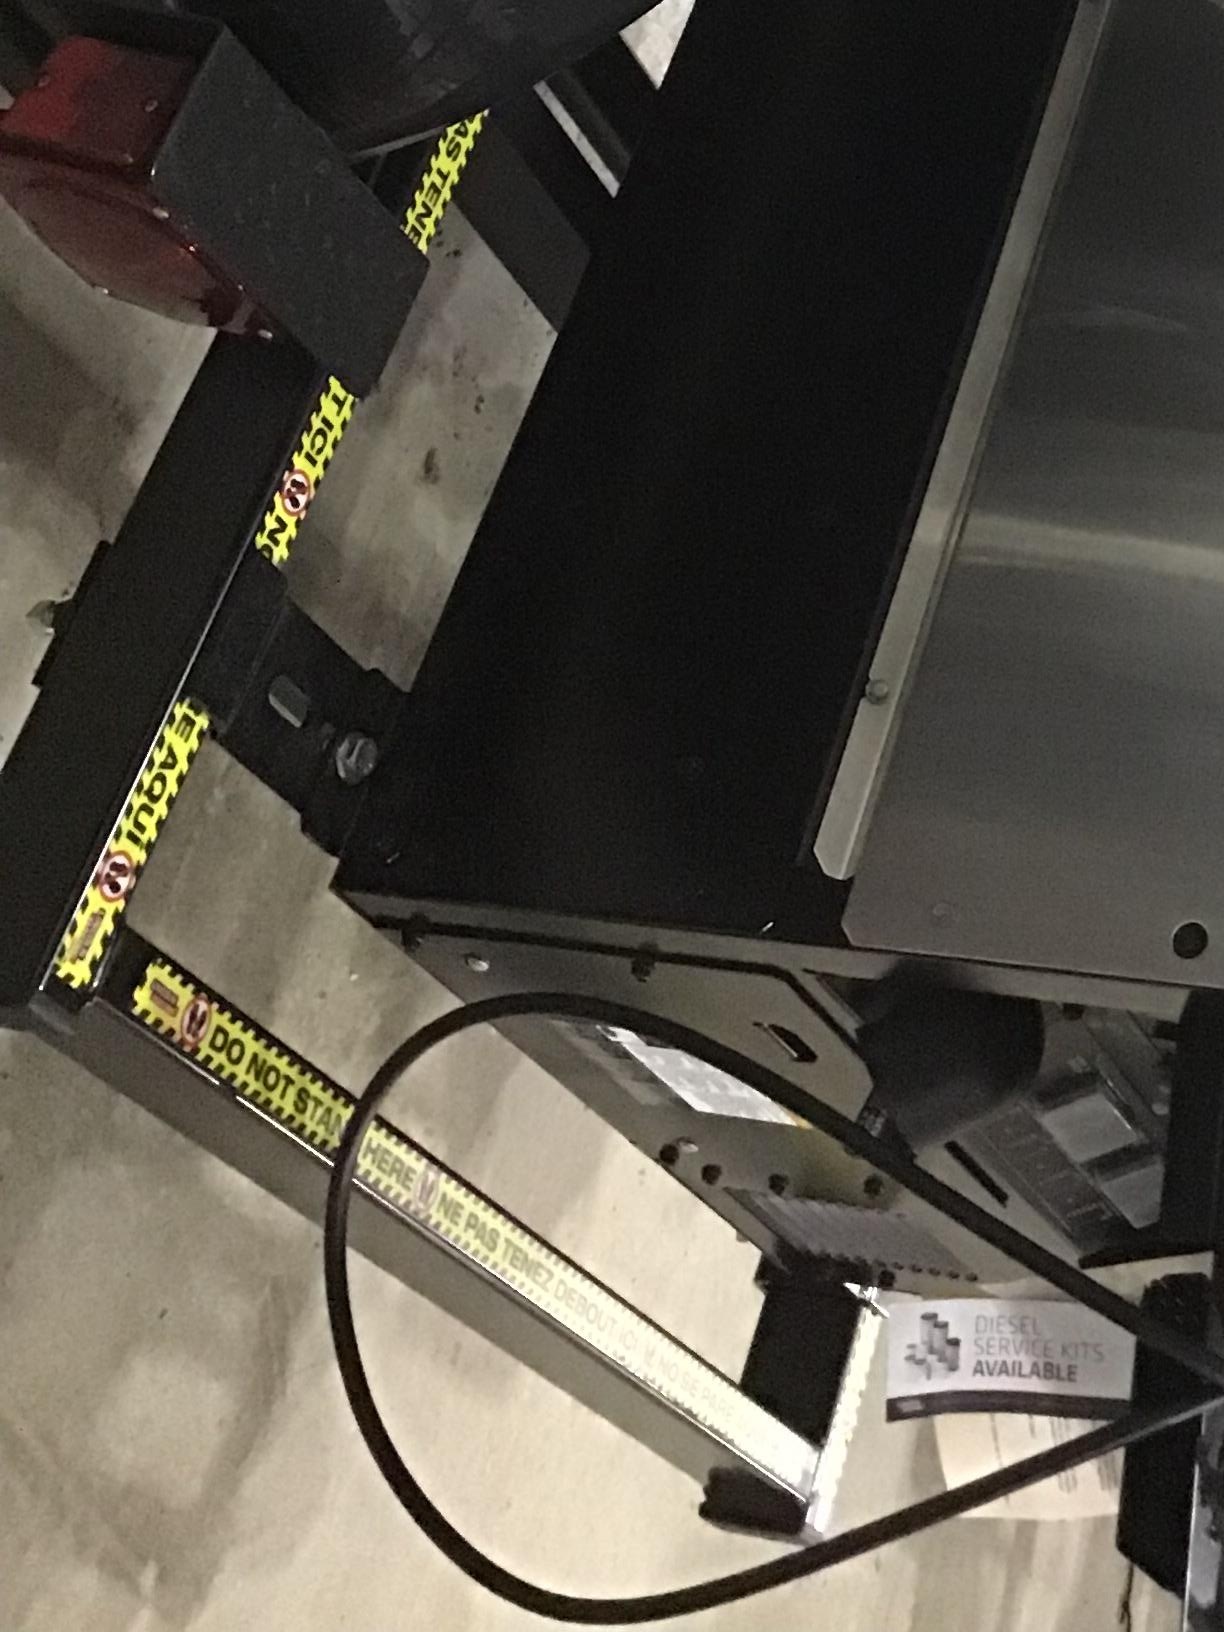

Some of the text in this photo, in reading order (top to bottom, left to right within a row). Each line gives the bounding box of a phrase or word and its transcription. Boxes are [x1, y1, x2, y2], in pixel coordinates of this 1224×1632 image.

[408, 121, 469, 245] AS TENE
[305, 416, 334, 468] ICI
[208, 1025, 245, 1066] DO
[246, 1052, 295, 1101] NOT
[363, 1137, 417, 1192] HERE
[437, 1192, 464, 1227] NE
[463, 1212, 500, 1253] PAS
[498, 1238, 554, 1291] TENEZ
[973, 1337, 1104, 1364] SERVICE KITS
[974, 1315, 1044, 1336] DIESEL
[972, 1360, 1078, 1383] AVAILABLE
